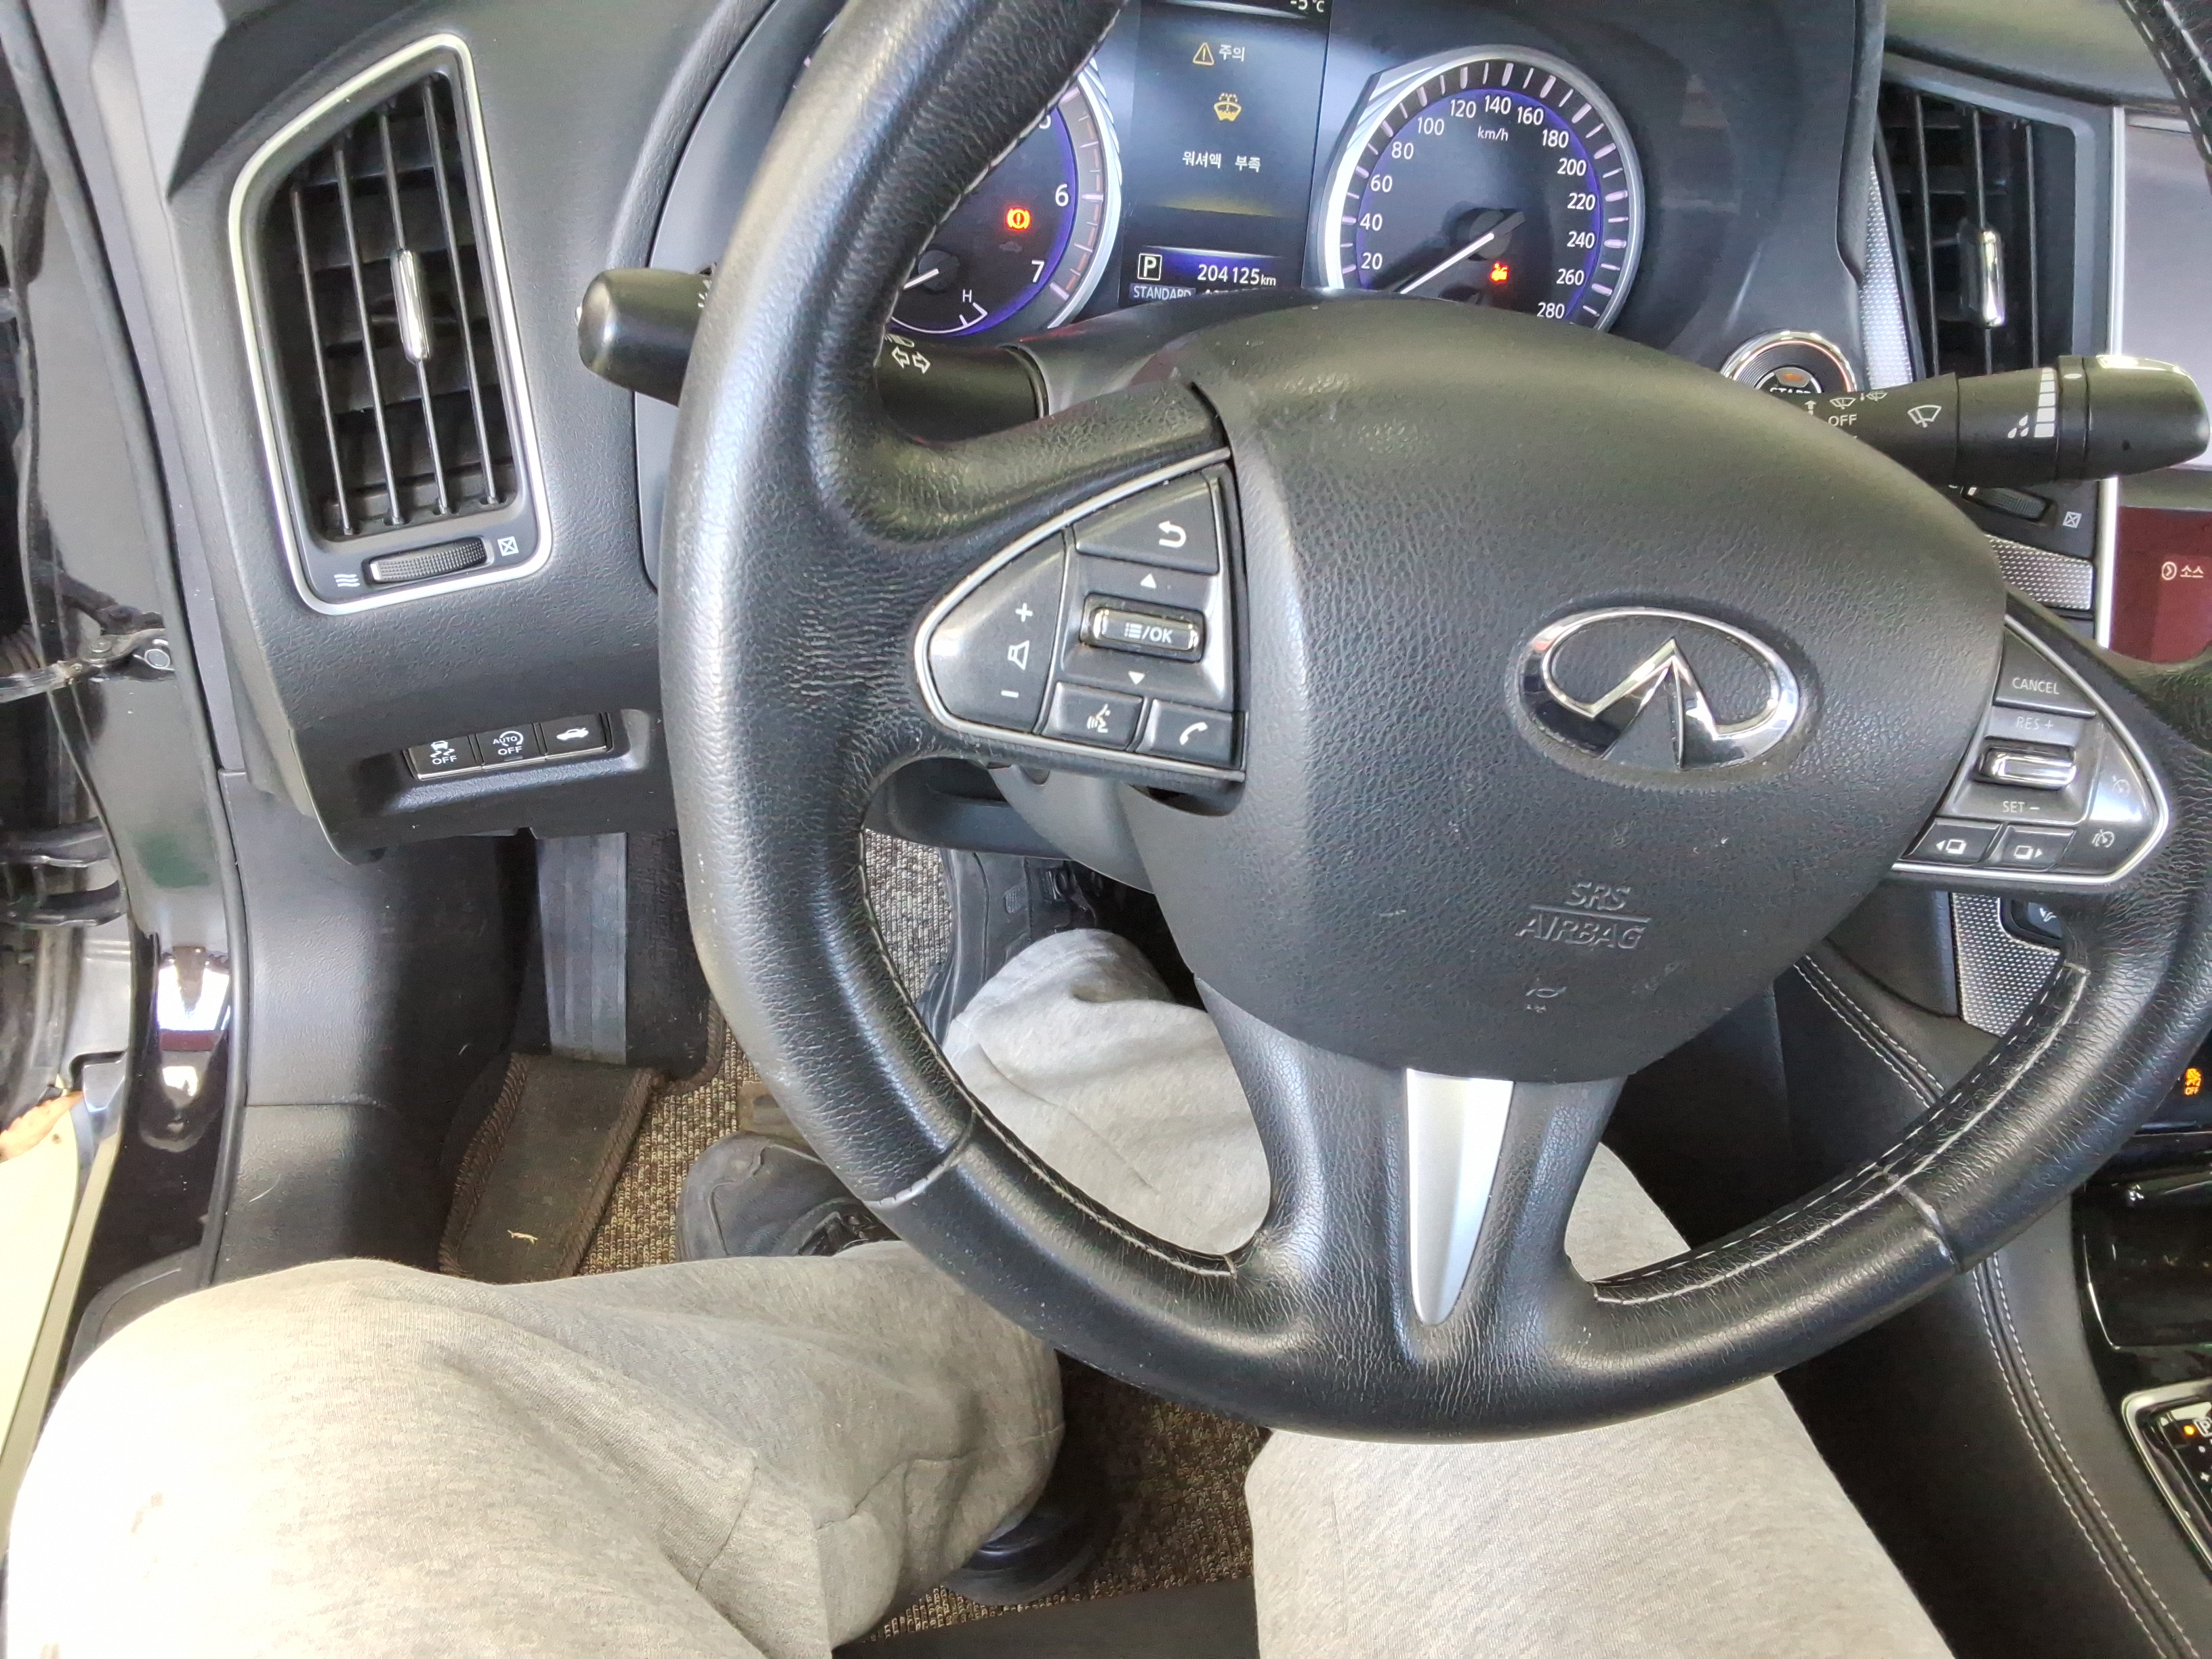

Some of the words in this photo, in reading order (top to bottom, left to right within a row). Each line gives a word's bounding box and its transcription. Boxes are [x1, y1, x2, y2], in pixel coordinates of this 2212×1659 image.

[1219, 44, 1245, 62] 주의
[1450, 100, 1477, 119] 120
[1484, 96, 1511, 115] 140
[1517, 106, 1544, 126] 160
[1417, 117, 1445, 136] 100
[1477, 126, 1509, 142] km/h
[1542, 129, 1569, 148] 180
[1391, 141, 1414, 160] 80
[1183, 150, 1222, 169] 워셔액
[1235, 155, 1261, 173] 부족
[1557, 159, 1586, 177] 200
[1370, 174, 1393, 192] 60
[1054, 184, 1069, 207] 6
[1567, 192, 1596, 211] 220
[1359, 212, 1383, 231] 40
[1566, 231, 1595, 249] 240
[1143, 256, 1156, 278] P
[1361, 251, 1383, 271] 20
[1031, 260, 1045, 283] 7
[1556, 268, 1584, 285] 260
[962, 289, 972, 303] H
[1536, 301, 1565, 319] 280
[1828, 413, 1857, 427] OFF
[2180, 565, 2204, 578] 소스
[2012, 677, 2060, 695] CANCEL
[2016, 716, 2041, 730] RES
[493, 737, 517, 745] AUTO
[497, 746, 523, 756] OFF
[432, 756, 457, 765] OFF
[2003, 802, 2025, 813] SET
[1566, 882, 1631, 912] SRS
[1515, 915, 1647, 949] AIRBAG
